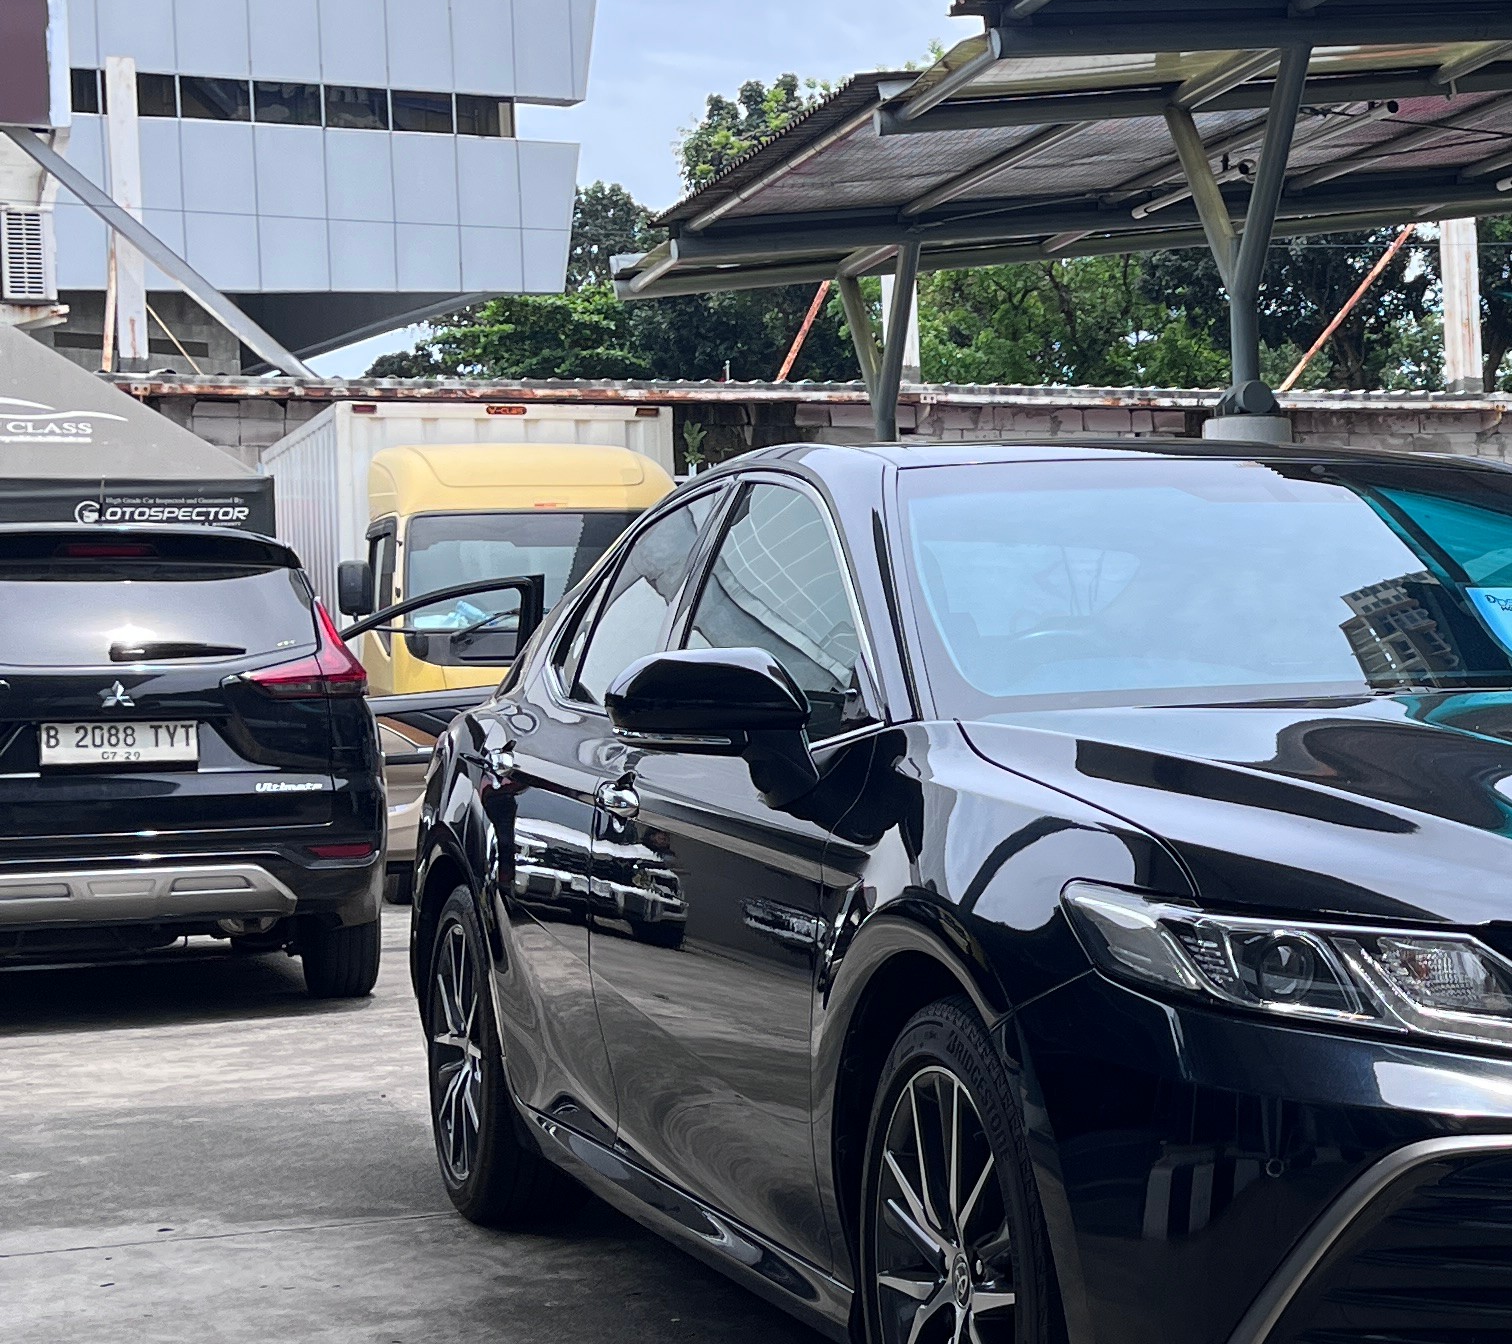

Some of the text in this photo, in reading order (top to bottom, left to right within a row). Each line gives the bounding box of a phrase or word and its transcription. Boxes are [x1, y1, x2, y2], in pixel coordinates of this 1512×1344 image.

[6, 421, 93, 434] CLASS
[105, 507, 249, 520] OTOSPECTOR
[44, 724, 193, 749] B 2088 TYT
